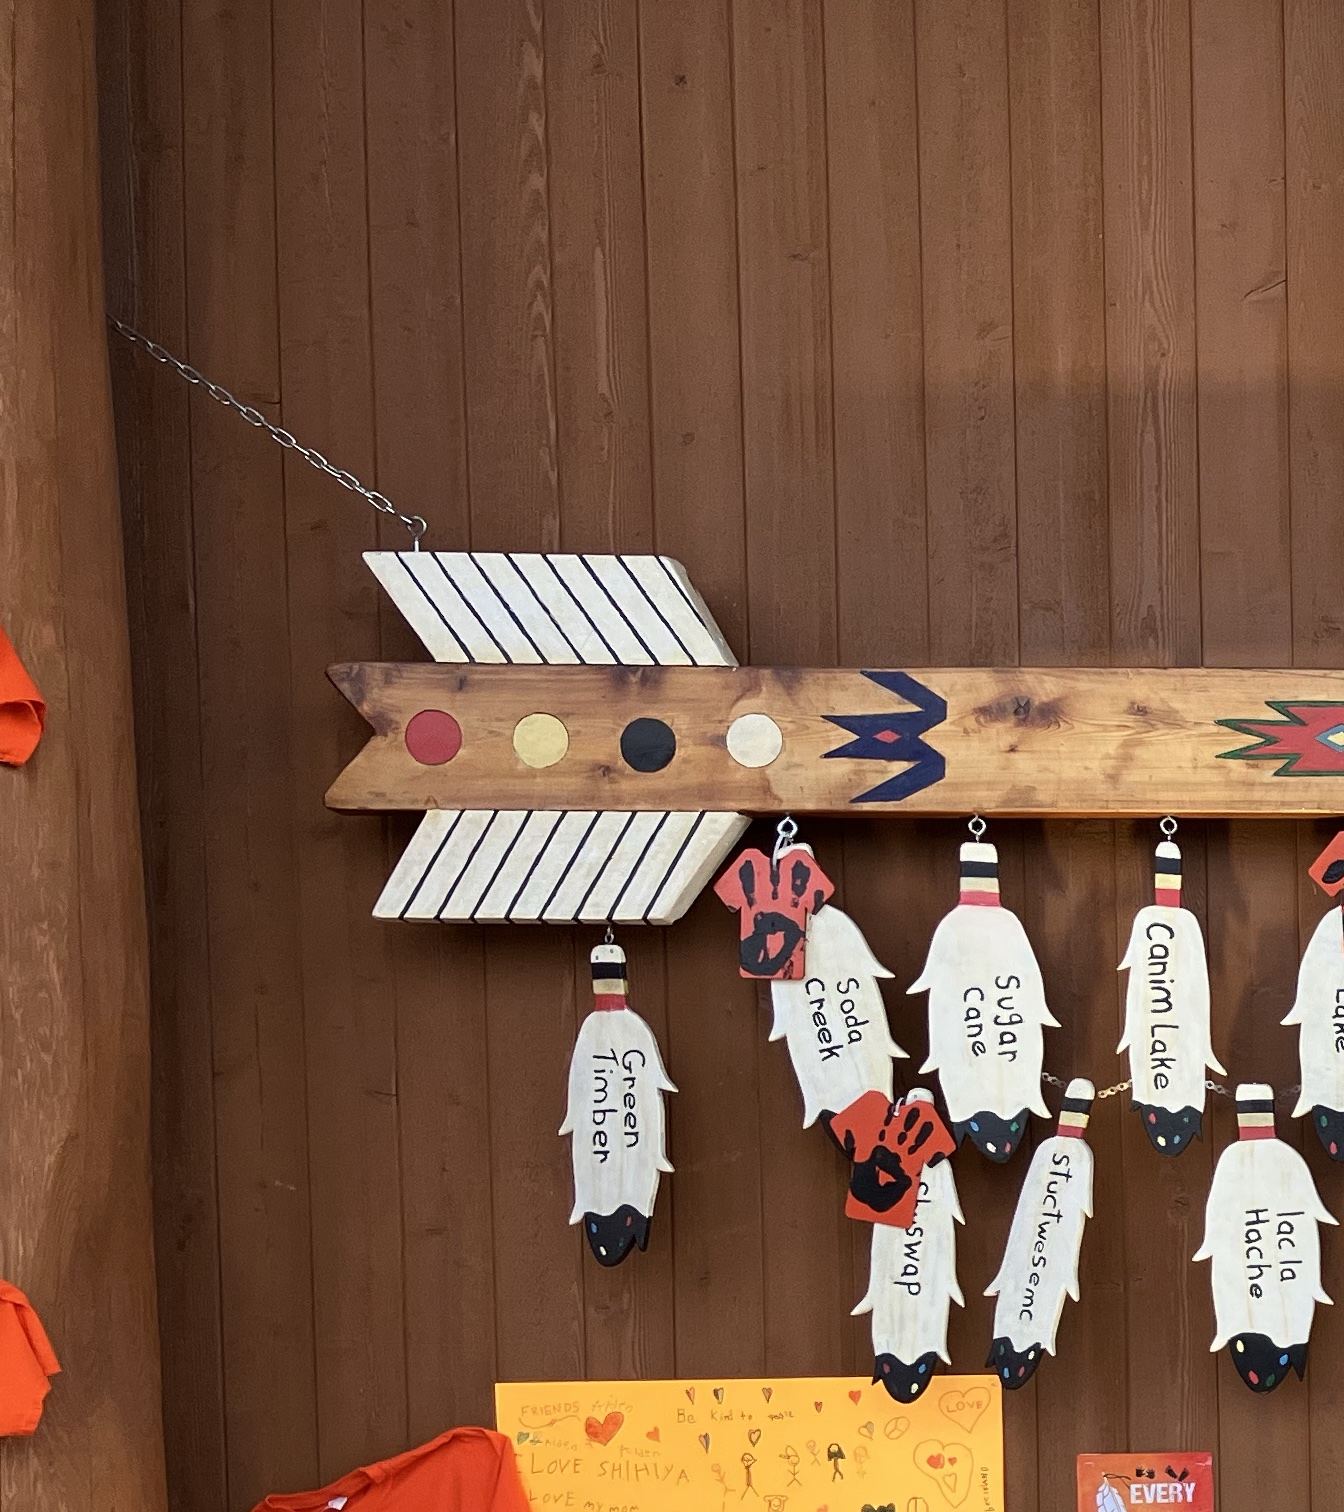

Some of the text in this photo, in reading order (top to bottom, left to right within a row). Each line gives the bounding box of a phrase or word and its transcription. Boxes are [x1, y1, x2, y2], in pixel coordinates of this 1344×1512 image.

[804, 977, 846, 1062] Creek
[836, 977, 868, 1045] Soda
[963, 987, 986, 1057] Cane
[993, 975, 1023, 1062] Sugar
[1146, 922, 1179, 1090] Canim Lake
[592, 1048, 620, 1164] Timber
[621, 1049, 646, 1148] Green
[1244, 1208, 1272, 1299] Hache
[520, 1401, 580, 1417] FRIENDS
[677, 1408, 696, 1424] Be
[946, 1400, 983, 1413] LOVE
[529, 1489, 576, 1507] LOVE
[531, 1452, 691, 1487] LOVE SHIHIYA
[1130, 1481, 1196, 1505] EVERY
